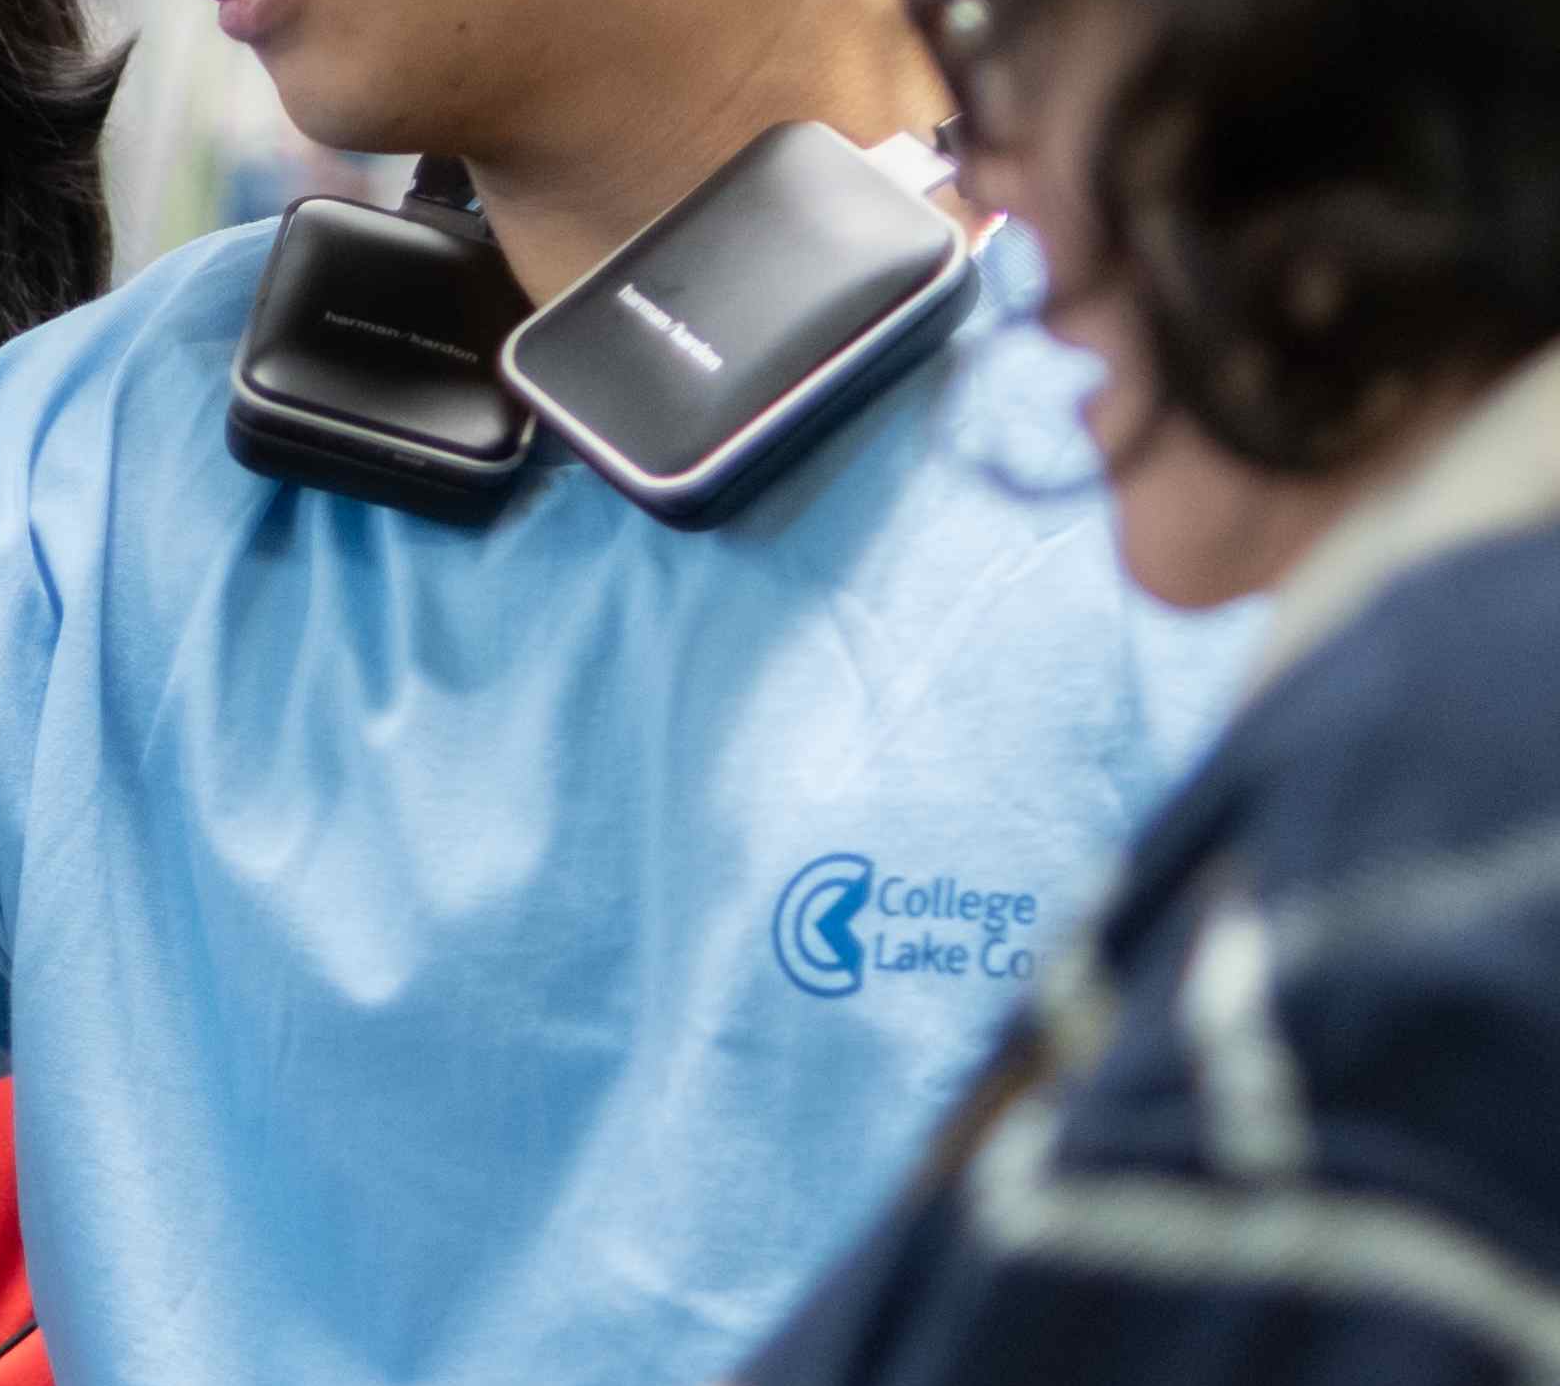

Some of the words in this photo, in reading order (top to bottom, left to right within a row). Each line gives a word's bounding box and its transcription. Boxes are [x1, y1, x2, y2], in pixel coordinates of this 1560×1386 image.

[877, 875, 1036, 933] College
[874, 932, 968, 975] Lake
[981, 937, 1035, 980] Co
